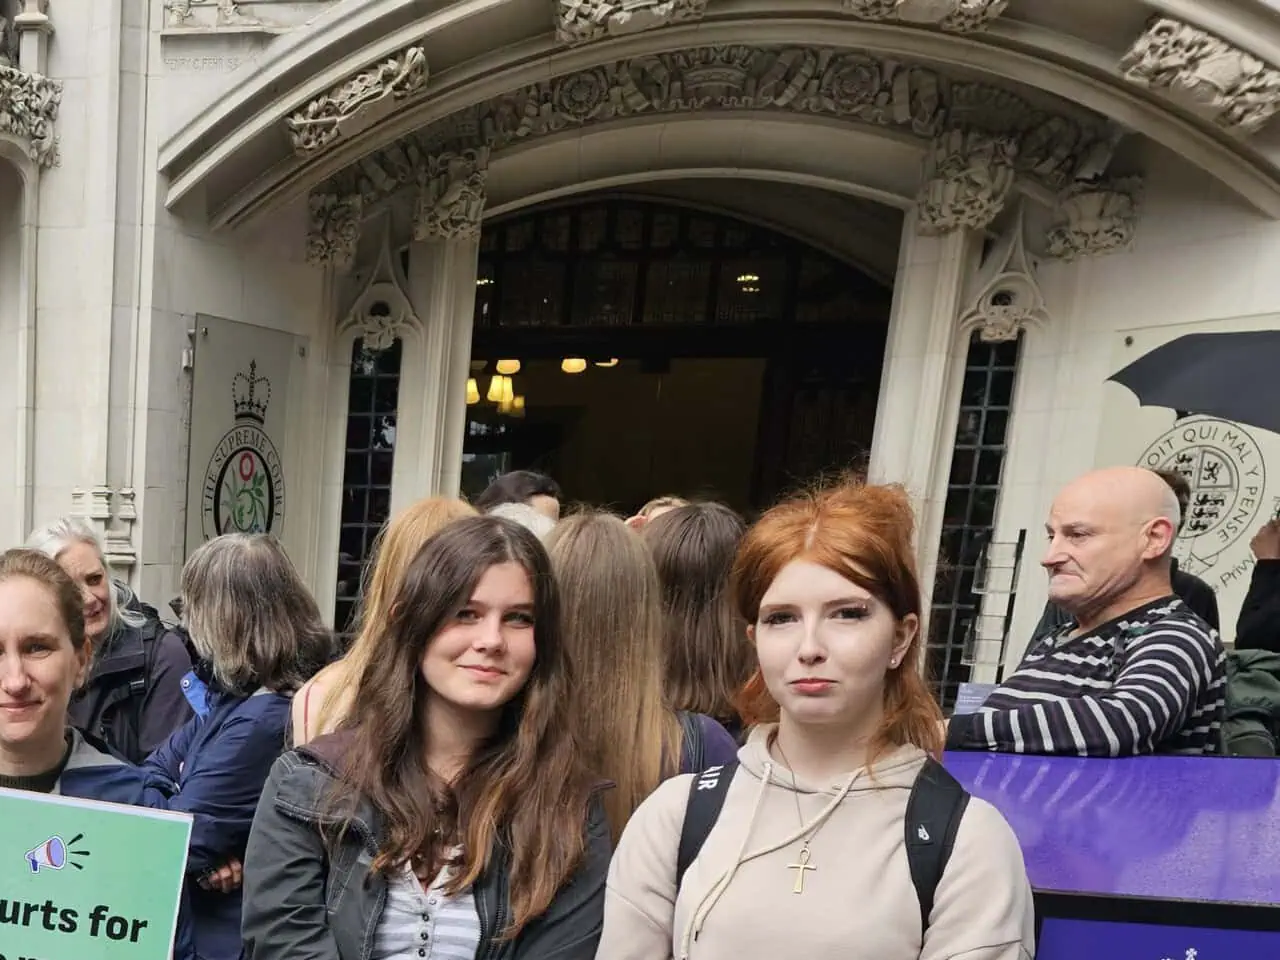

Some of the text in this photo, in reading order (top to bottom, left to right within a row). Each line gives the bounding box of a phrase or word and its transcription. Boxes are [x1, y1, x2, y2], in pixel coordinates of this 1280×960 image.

[1182, 426, 1219, 442] QUI
[1221, 430, 1247, 464] MAL
[204, 428, 284, 517] THE SUPREME COURT
[1245, 463, 1259, 477] Y
[1219, 486, 1258, 543] PENSE
[89, 905, 148, 943] for
